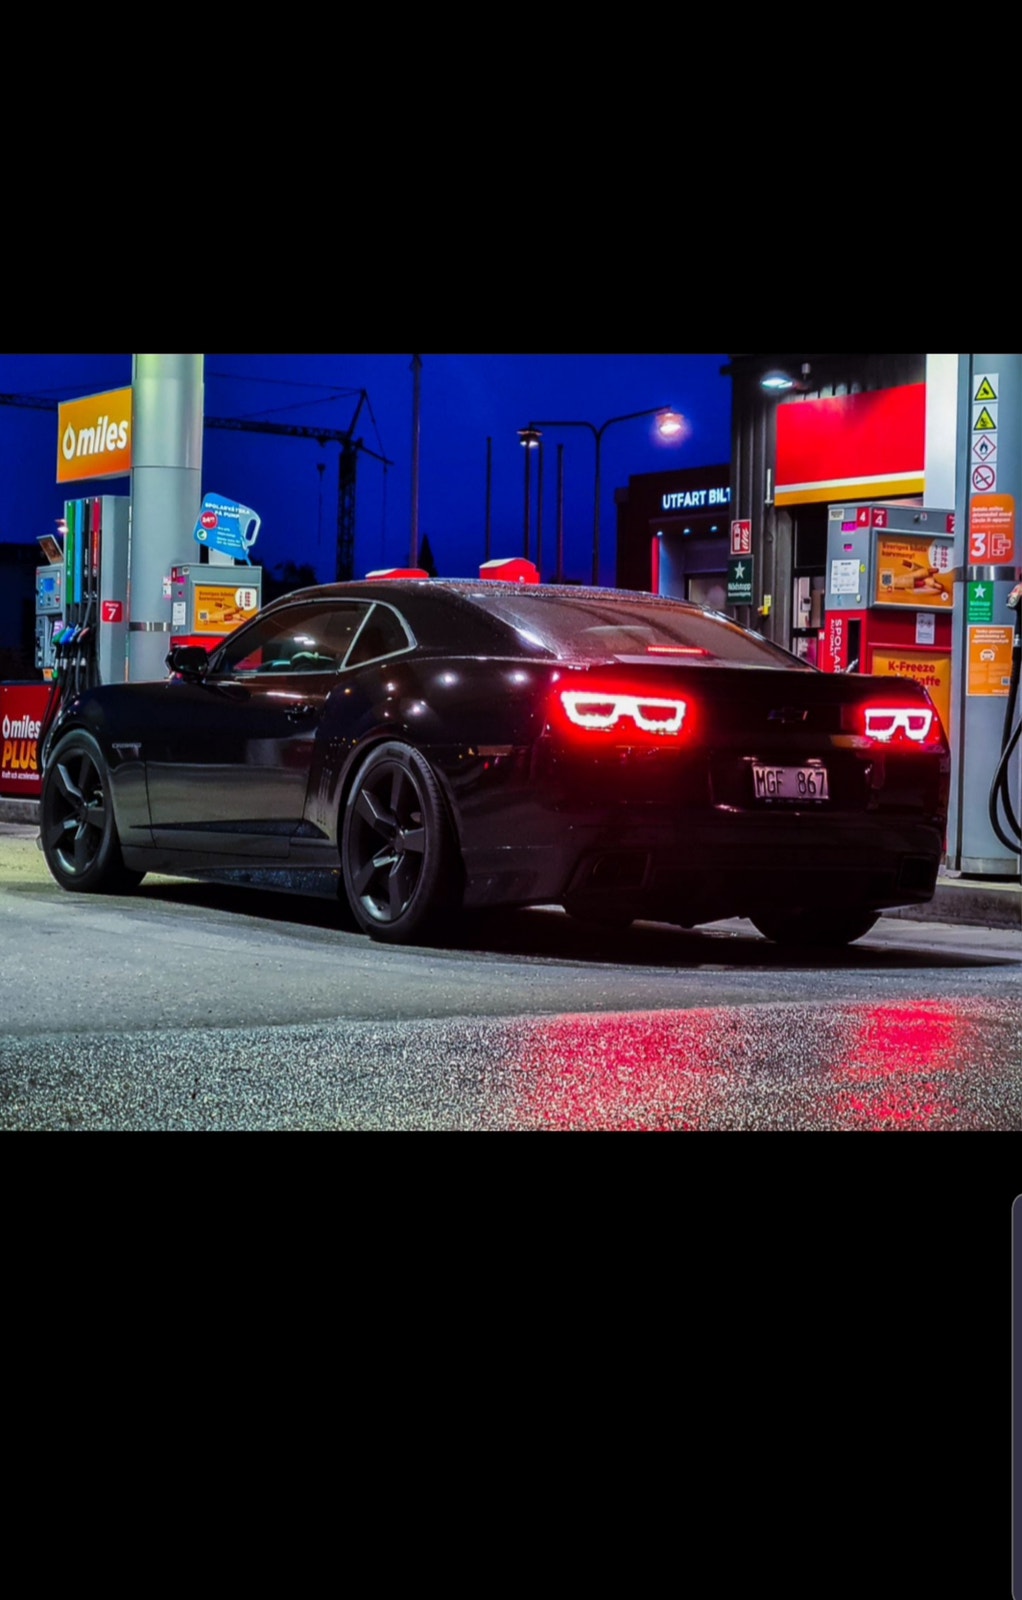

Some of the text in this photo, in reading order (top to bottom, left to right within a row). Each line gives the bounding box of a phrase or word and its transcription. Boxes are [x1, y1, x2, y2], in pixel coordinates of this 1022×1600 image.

[662, 490, 707, 509] UTFART
[860, 511, 866, 522] 4
[875, 515, 883, 526] 4
[971, 533, 986, 557] 3
[108, 608, 116, 620] 7
[888, 661, 936, 673] K-Freeze
[2, 741, 37, 770] PLUS
[755, 770, 825, 795] MGF 867
